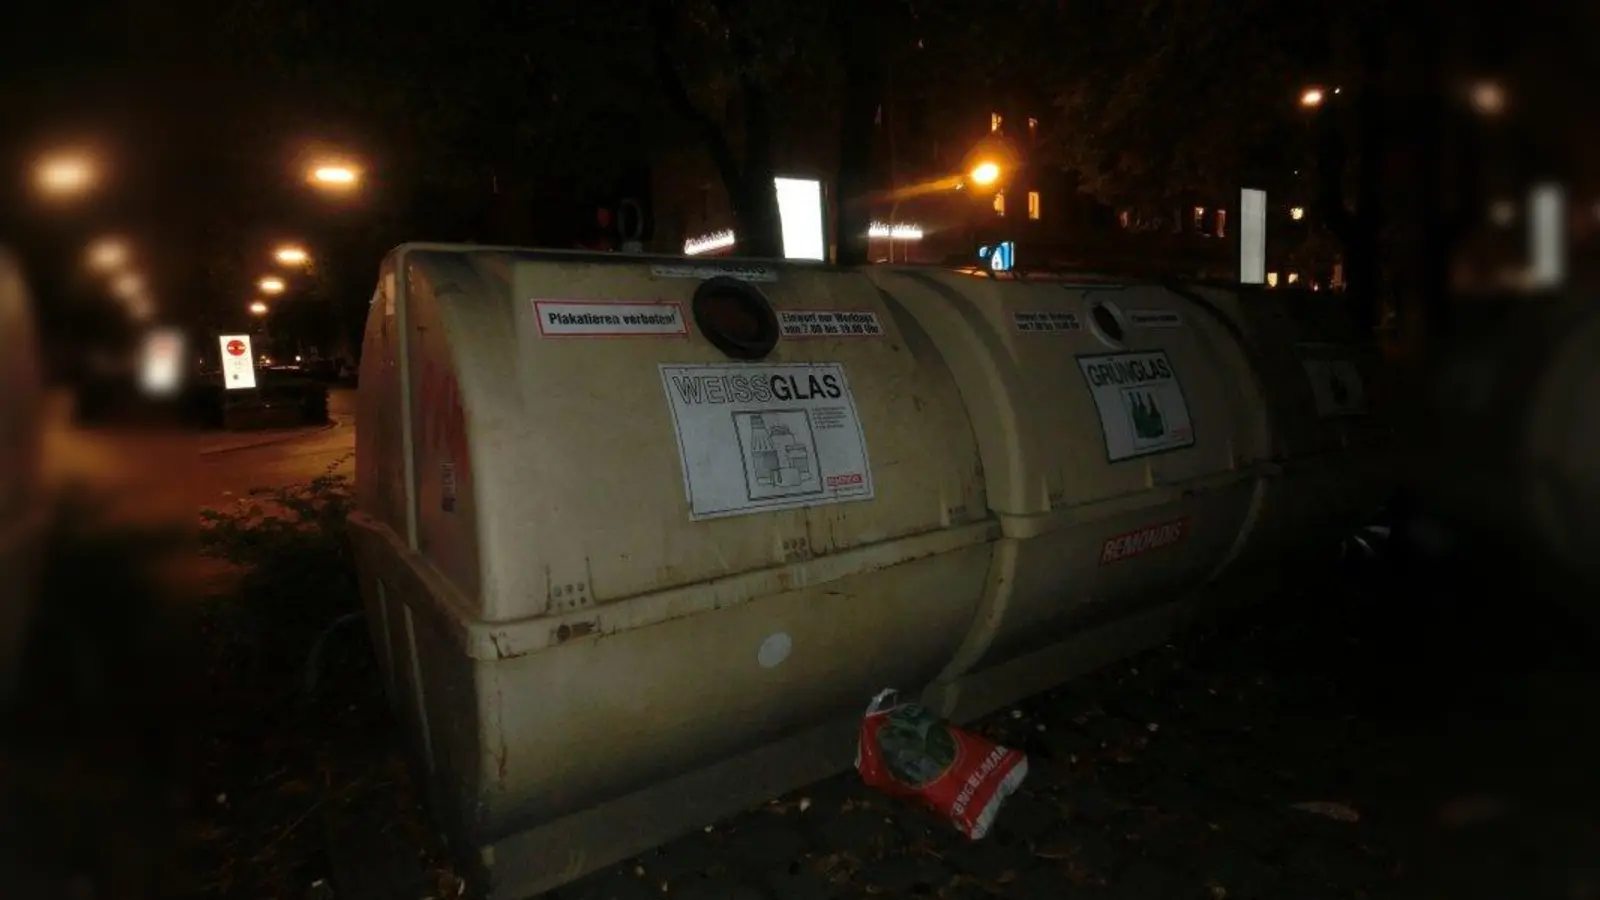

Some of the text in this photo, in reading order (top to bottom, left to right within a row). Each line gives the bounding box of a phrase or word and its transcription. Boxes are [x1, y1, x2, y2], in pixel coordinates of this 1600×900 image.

[548, 313, 677, 326] Plakatieren verboten!
[1086, 358, 1172, 387] GRÜNGLAS
[672, 374, 842, 404] WEISSGLAS
[1101, 522, 1181, 562] REMONDIS
